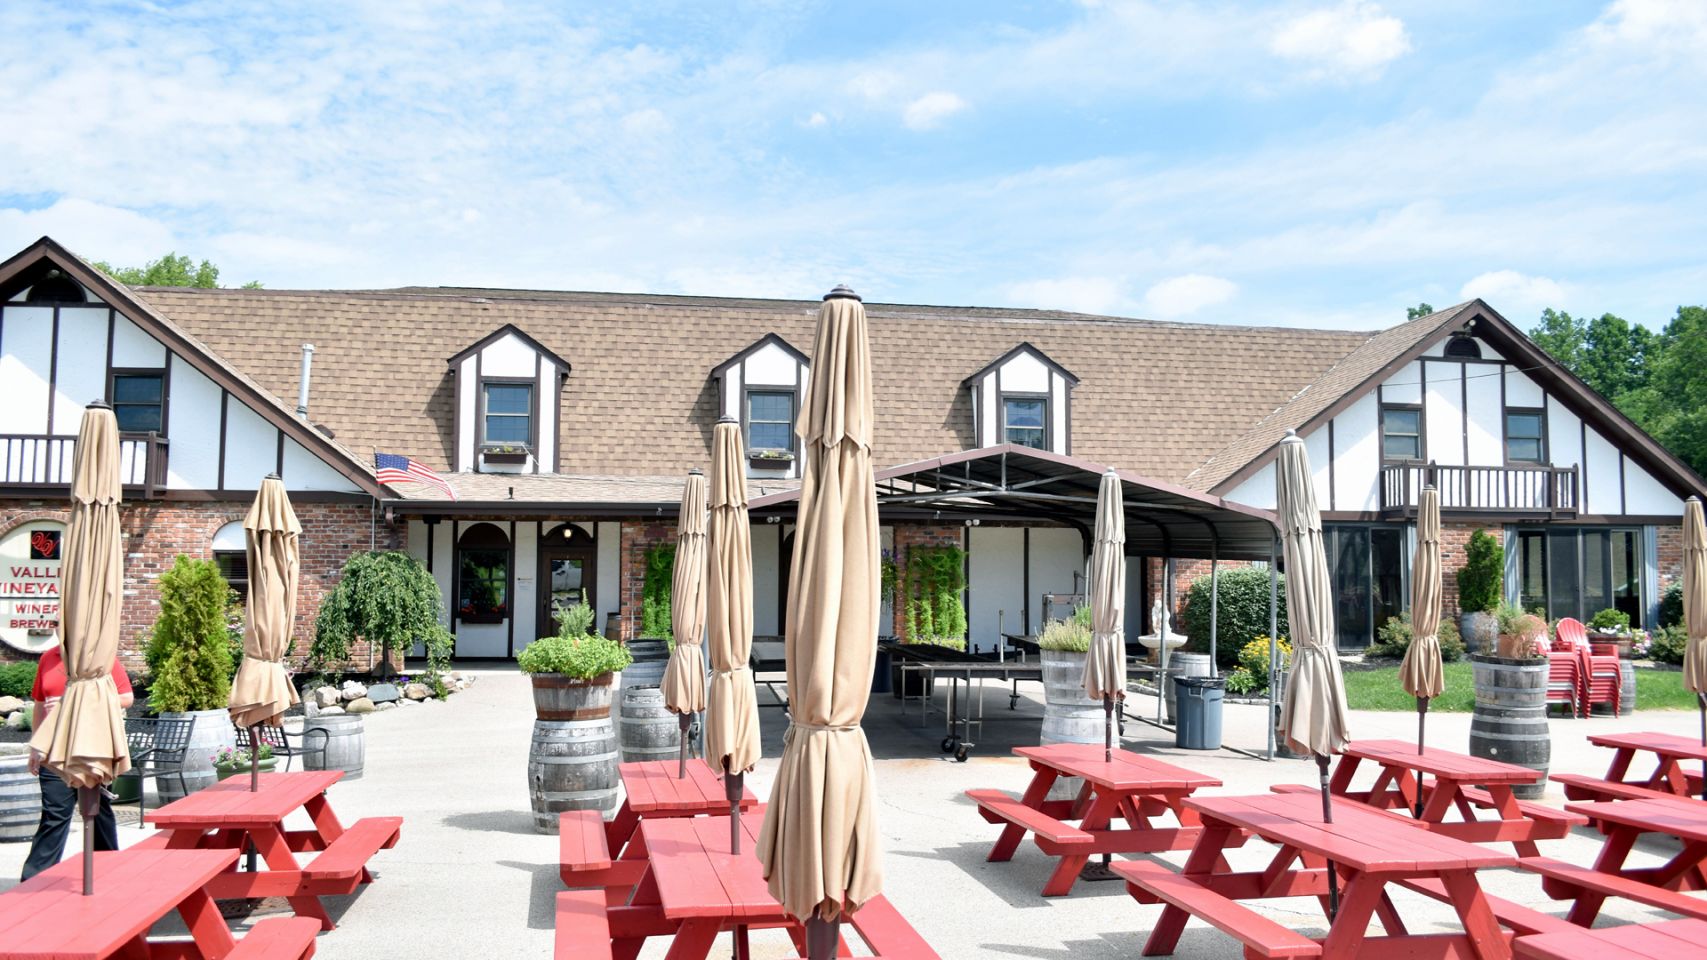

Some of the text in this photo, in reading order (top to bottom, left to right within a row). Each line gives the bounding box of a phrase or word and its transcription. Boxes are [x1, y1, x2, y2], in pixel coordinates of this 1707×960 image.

[10, 566, 61, 578] VALL
[0, 582, 59, 594] INEYA
[15, 604, 59, 614] WINER
[10, 619, 57, 629] BREWE
